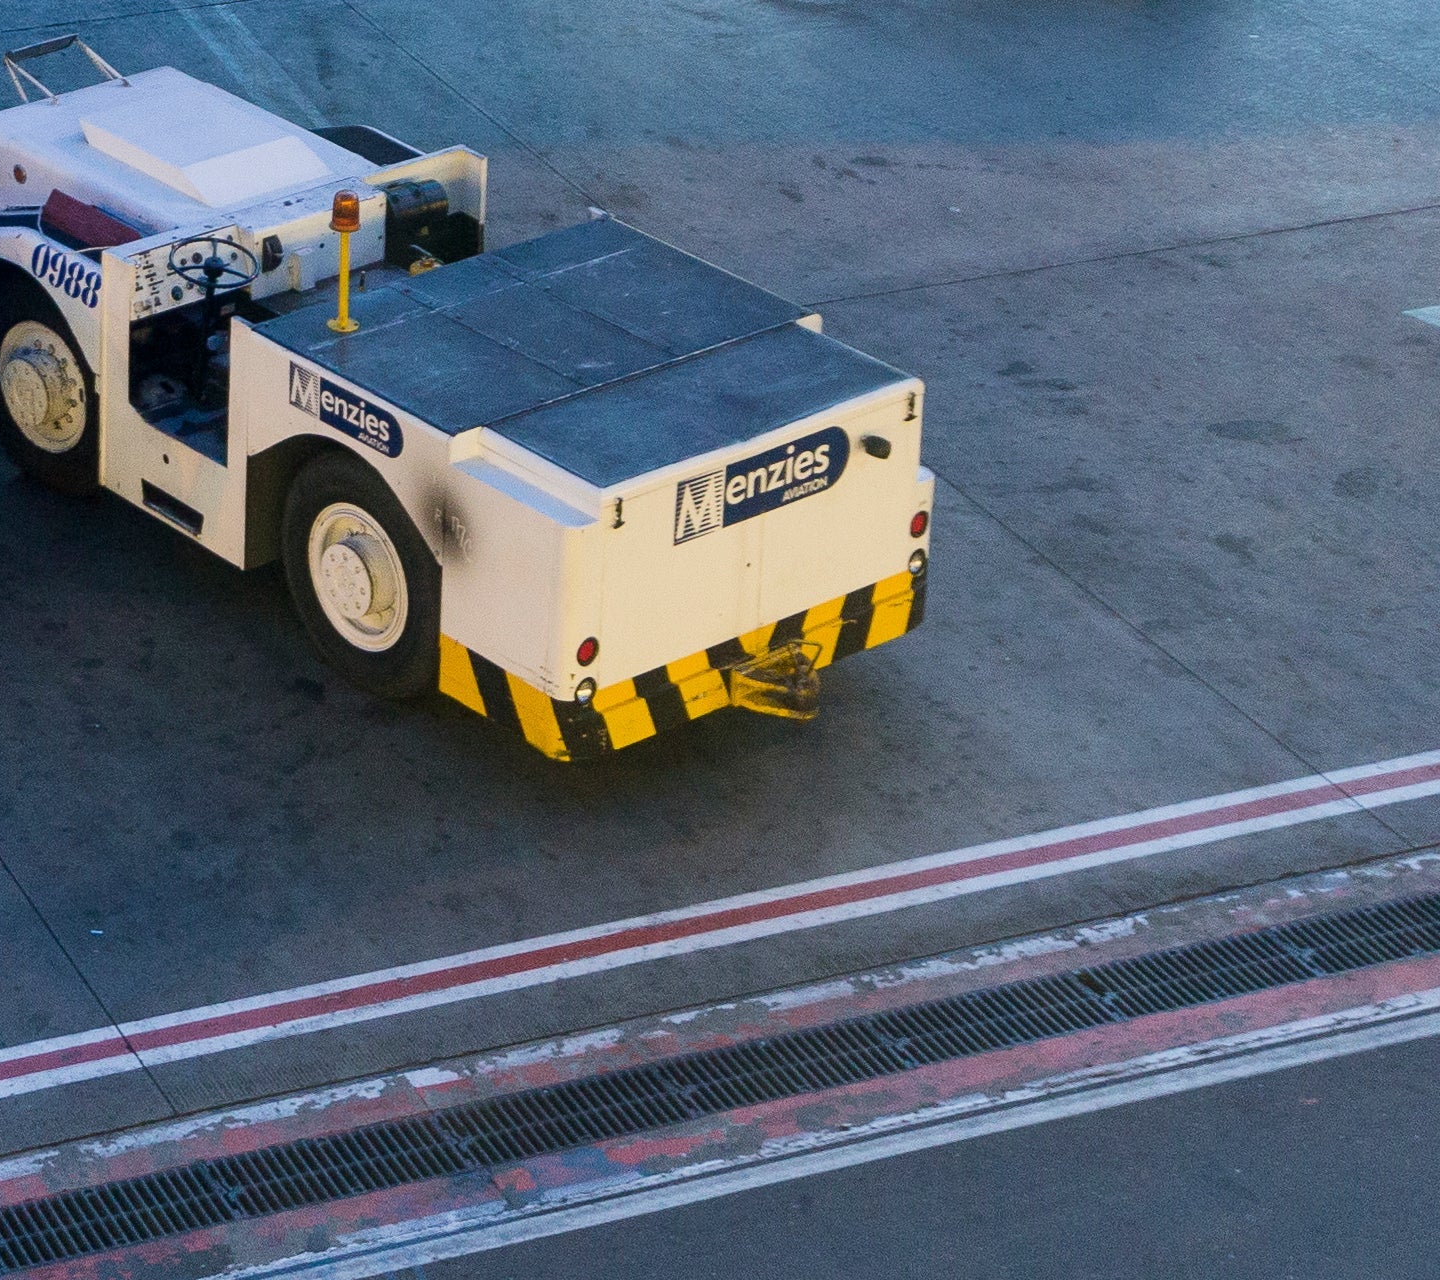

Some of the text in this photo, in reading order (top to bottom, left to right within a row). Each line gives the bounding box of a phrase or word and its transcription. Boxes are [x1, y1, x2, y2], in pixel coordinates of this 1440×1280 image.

[31, 243, 102, 309] 0988
[290, 362, 391, 442] Menzies
[675, 443, 832, 542] Menzies
[781, 475, 829, 503] AVIATION
